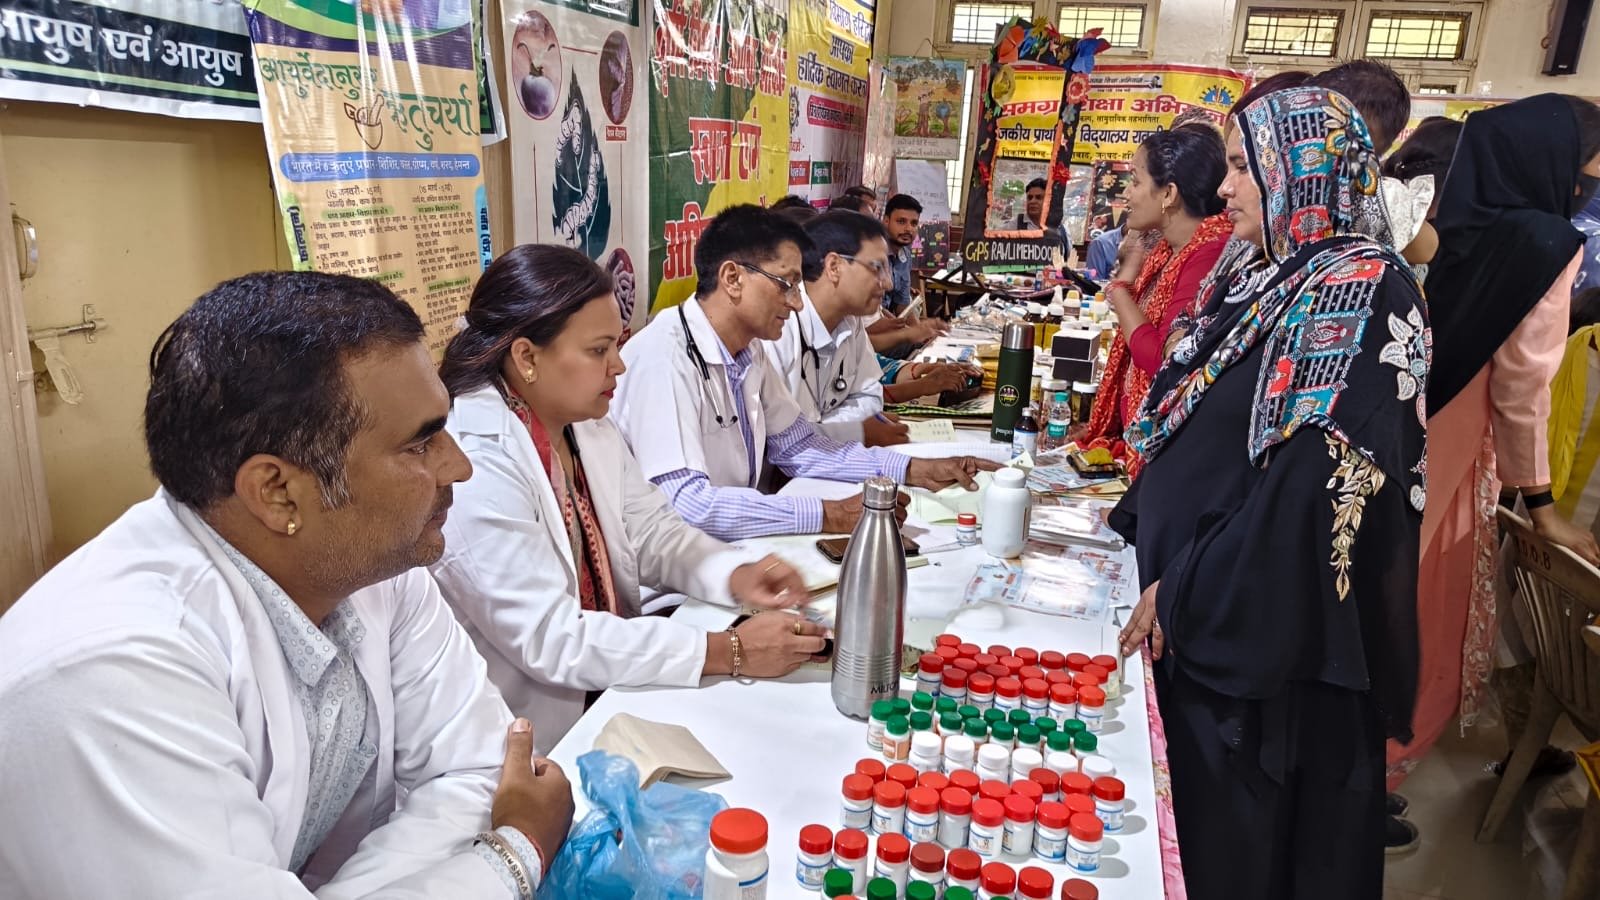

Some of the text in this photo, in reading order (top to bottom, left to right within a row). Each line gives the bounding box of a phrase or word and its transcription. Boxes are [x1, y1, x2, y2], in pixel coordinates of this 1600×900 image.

[101, 25, 152, 62] एवं
[161, 40, 244, 87] आयुष
[798, 52, 824, 85] हार्दिक
[826, 66, 851, 94] स्वागत
[1002, 100, 1060, 117] समग्र
[998, 123, 1031, 142] जकीय
[1034, 124, 1058, 143] प्राथ
[965, 241, 989, 262] GPS
